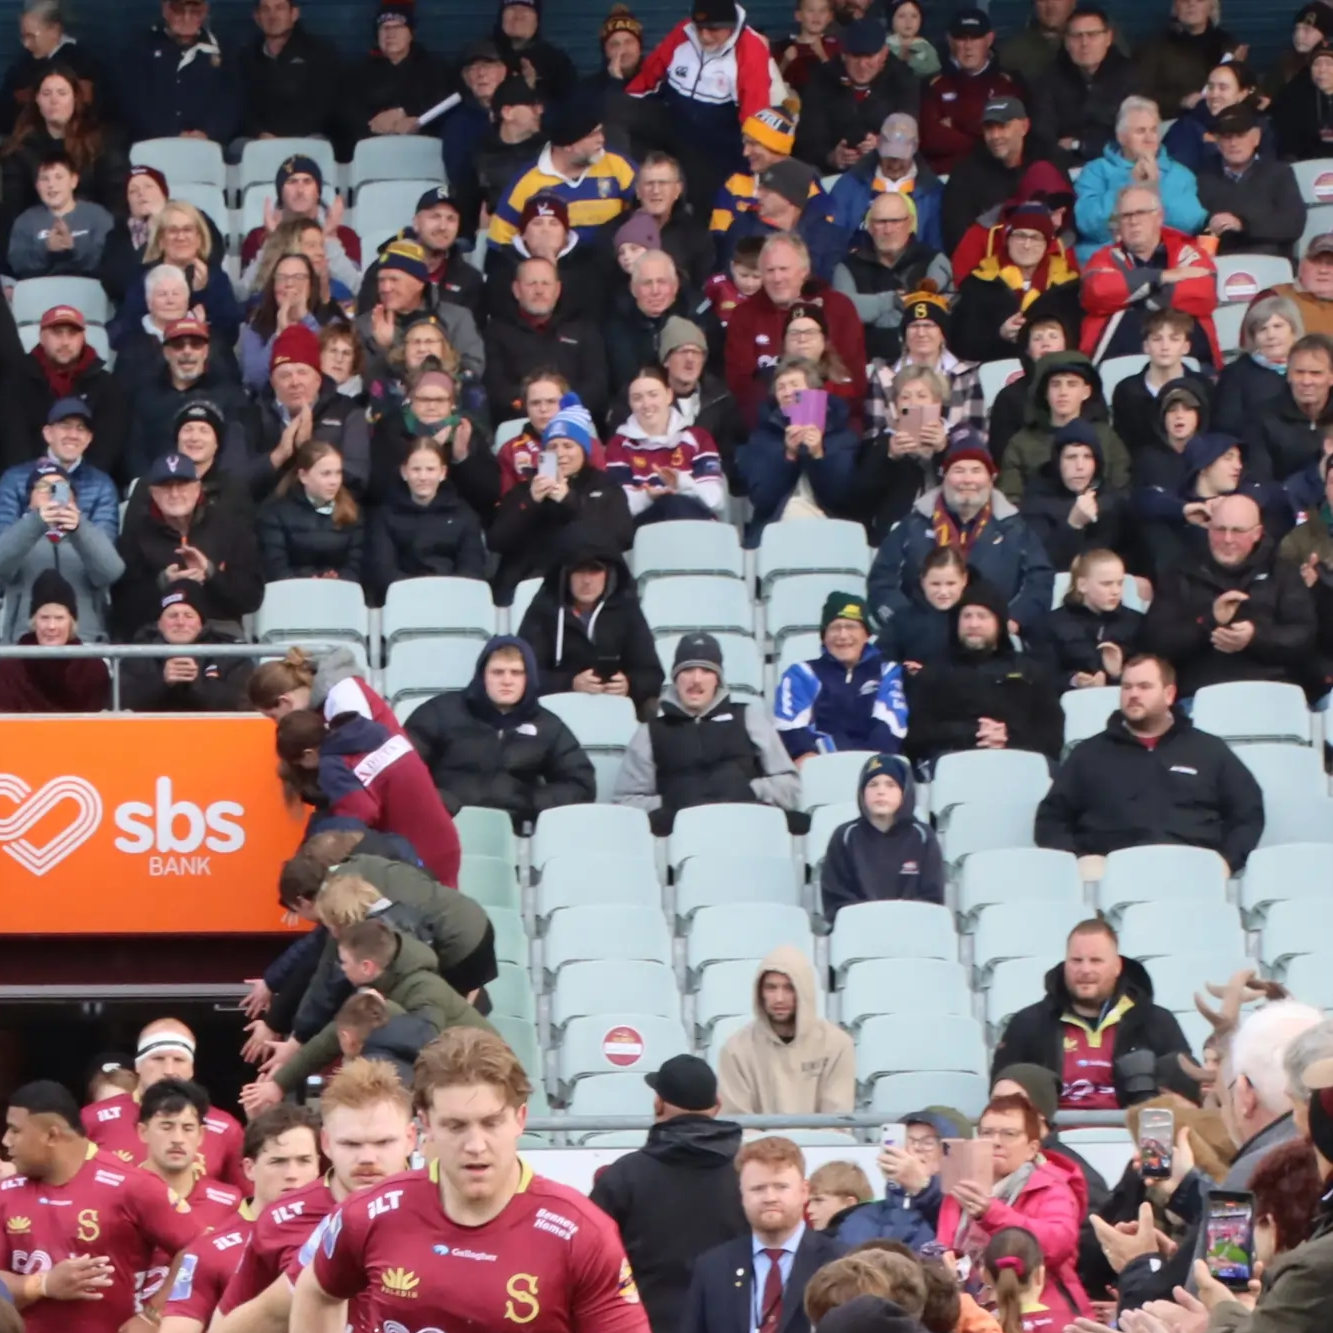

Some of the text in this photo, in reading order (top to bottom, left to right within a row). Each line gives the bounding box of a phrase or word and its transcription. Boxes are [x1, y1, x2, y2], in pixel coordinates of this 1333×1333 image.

[114, 775, 246, 854] sbs
[149, 856, 211, 876] BANK
[77, 1208, 101, 1241] S
[504, 1272, 541, 1324] S
